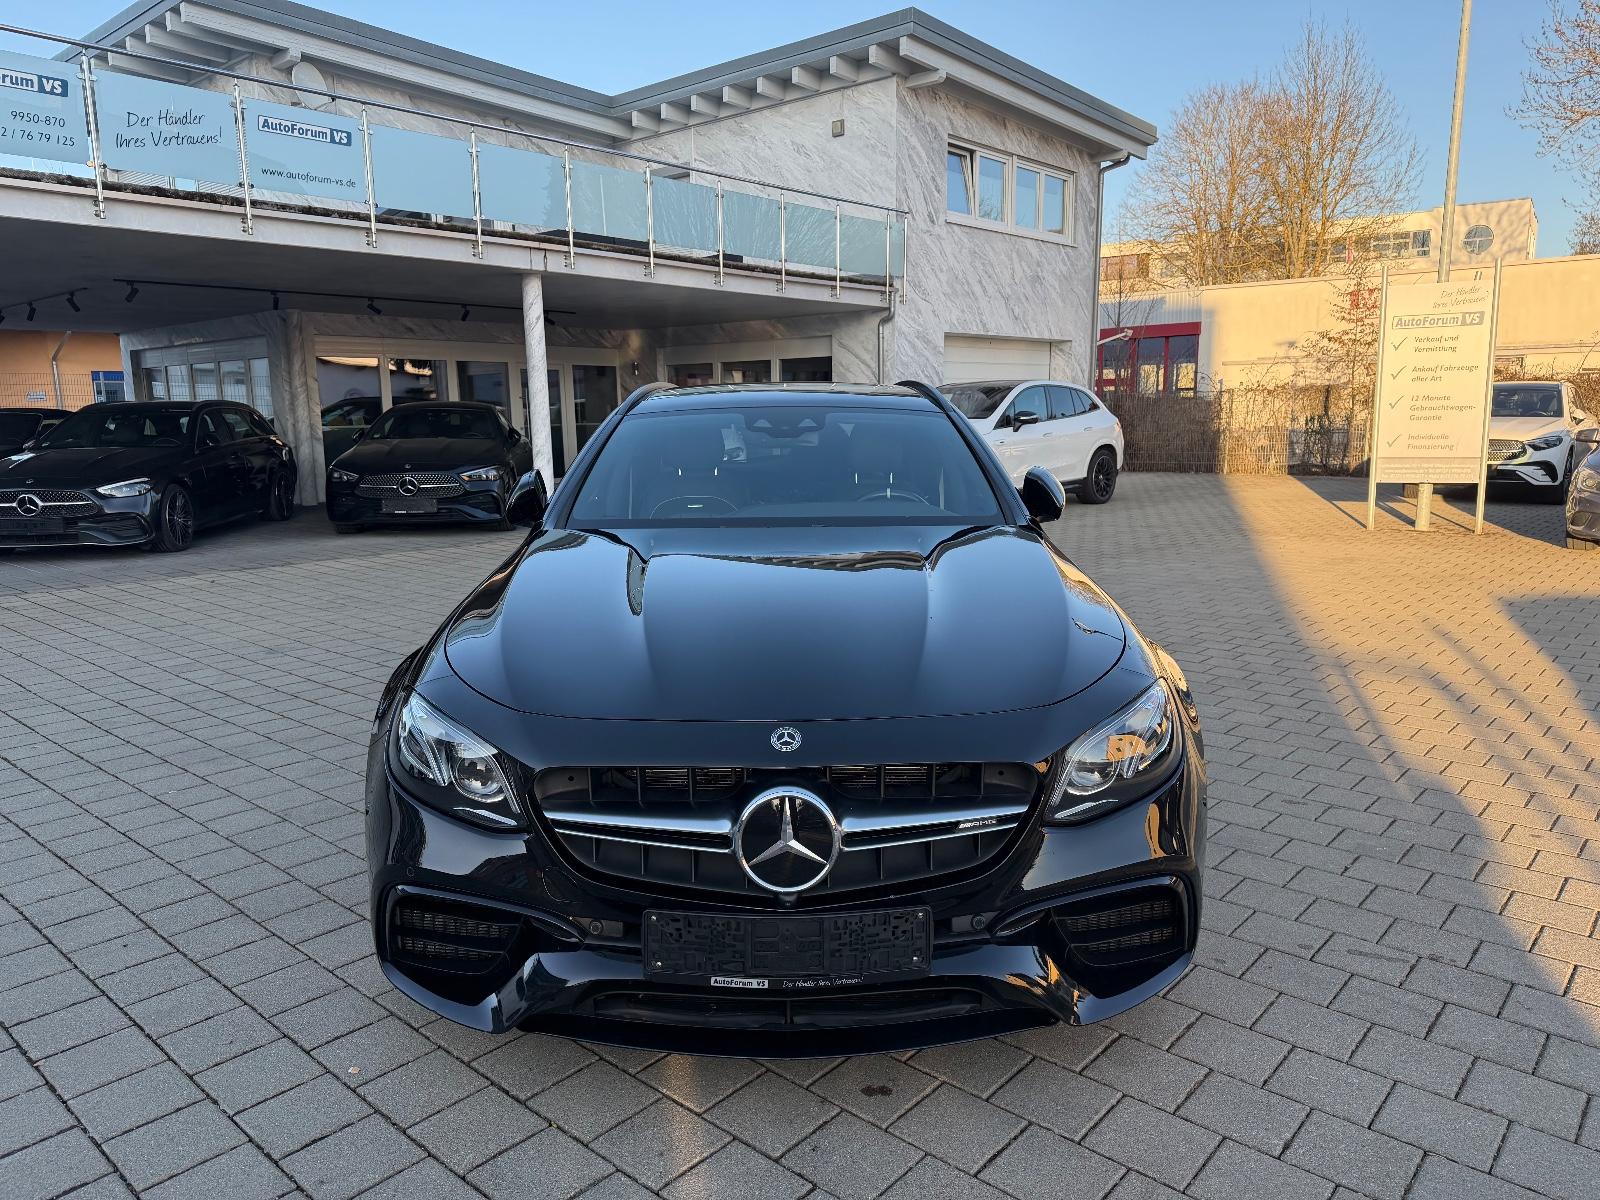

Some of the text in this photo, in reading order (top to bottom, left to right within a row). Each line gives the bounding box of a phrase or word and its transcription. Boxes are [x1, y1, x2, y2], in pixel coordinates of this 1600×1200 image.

[0, 74, 62, 94] rum VS
[10, 110, 66, 128] 9950-870
[126, 108, 205, 128] Der Händler
[115, 125, 222, 149] Ihres Vertrauens!
[261, 118, 348, 144] AutoForum VS
[57, 134, 75, 147] 125
[261, 167, 356, 188] www.autoforum-vs.de
[1395, 312, 1480, 328] AutoForum VS
[1414, 334, 1460, 343] Verkauf und
[1414, 345, 1457, 353] Vermittlung
[1411, 364, 1479, 374] Ankauf Fahrzeuge
[1421, 394, 1451, 402] Monate
[1409, 404, 1476, 412] Gebrauchtwagen-
[713, 978, 753, 987] AutoForum
